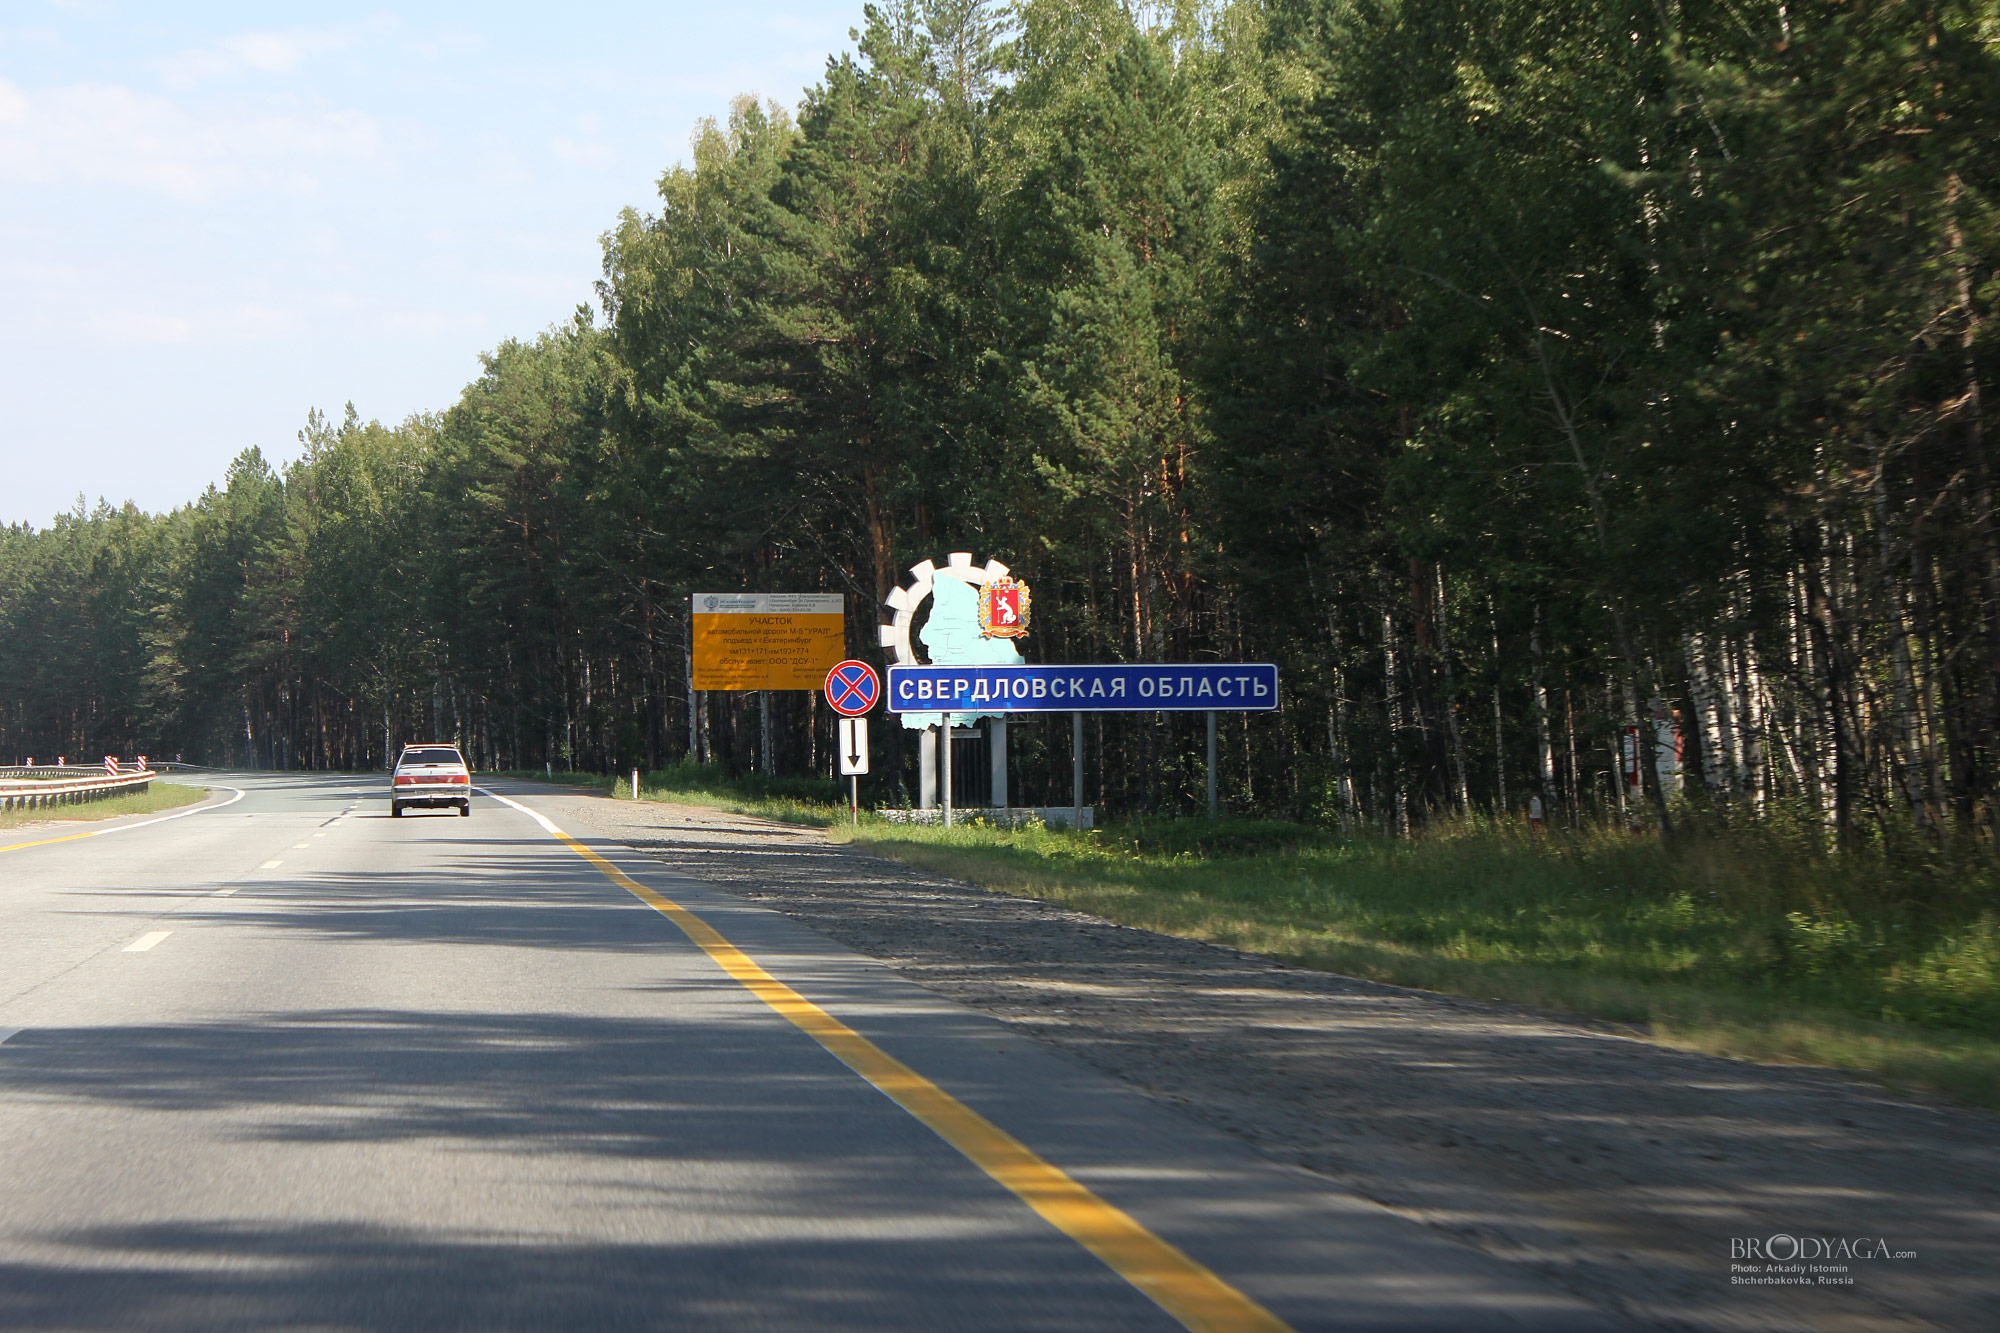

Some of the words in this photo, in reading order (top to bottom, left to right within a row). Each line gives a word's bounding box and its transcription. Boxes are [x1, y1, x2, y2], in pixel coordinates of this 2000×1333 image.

[749, 617, 793, 625] УЧАСТОК
[763, 628, 788, 636] дороги
[898, 677, 1127, 702] СВЕРДЛОВСКАЯ
[1138, 677, 1269, 698] ОБЛАСТЬ
